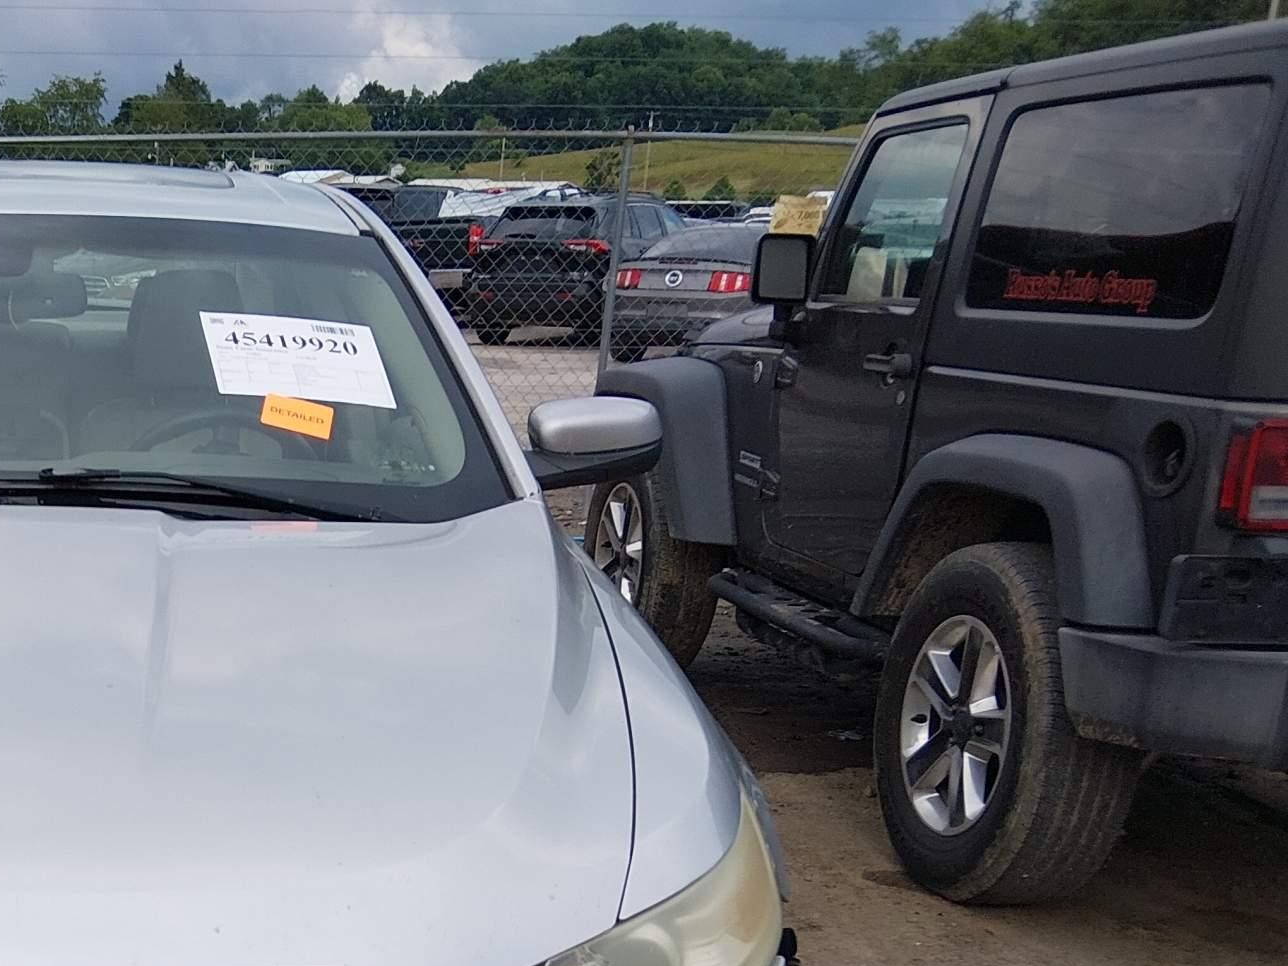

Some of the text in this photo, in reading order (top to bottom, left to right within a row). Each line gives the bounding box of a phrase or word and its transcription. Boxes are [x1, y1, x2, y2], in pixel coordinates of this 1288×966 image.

[1100, 270, 1157, 312] Group
[224, 331, 358, 356] 45419920
[270, 406, 325, 425] DETAILED
